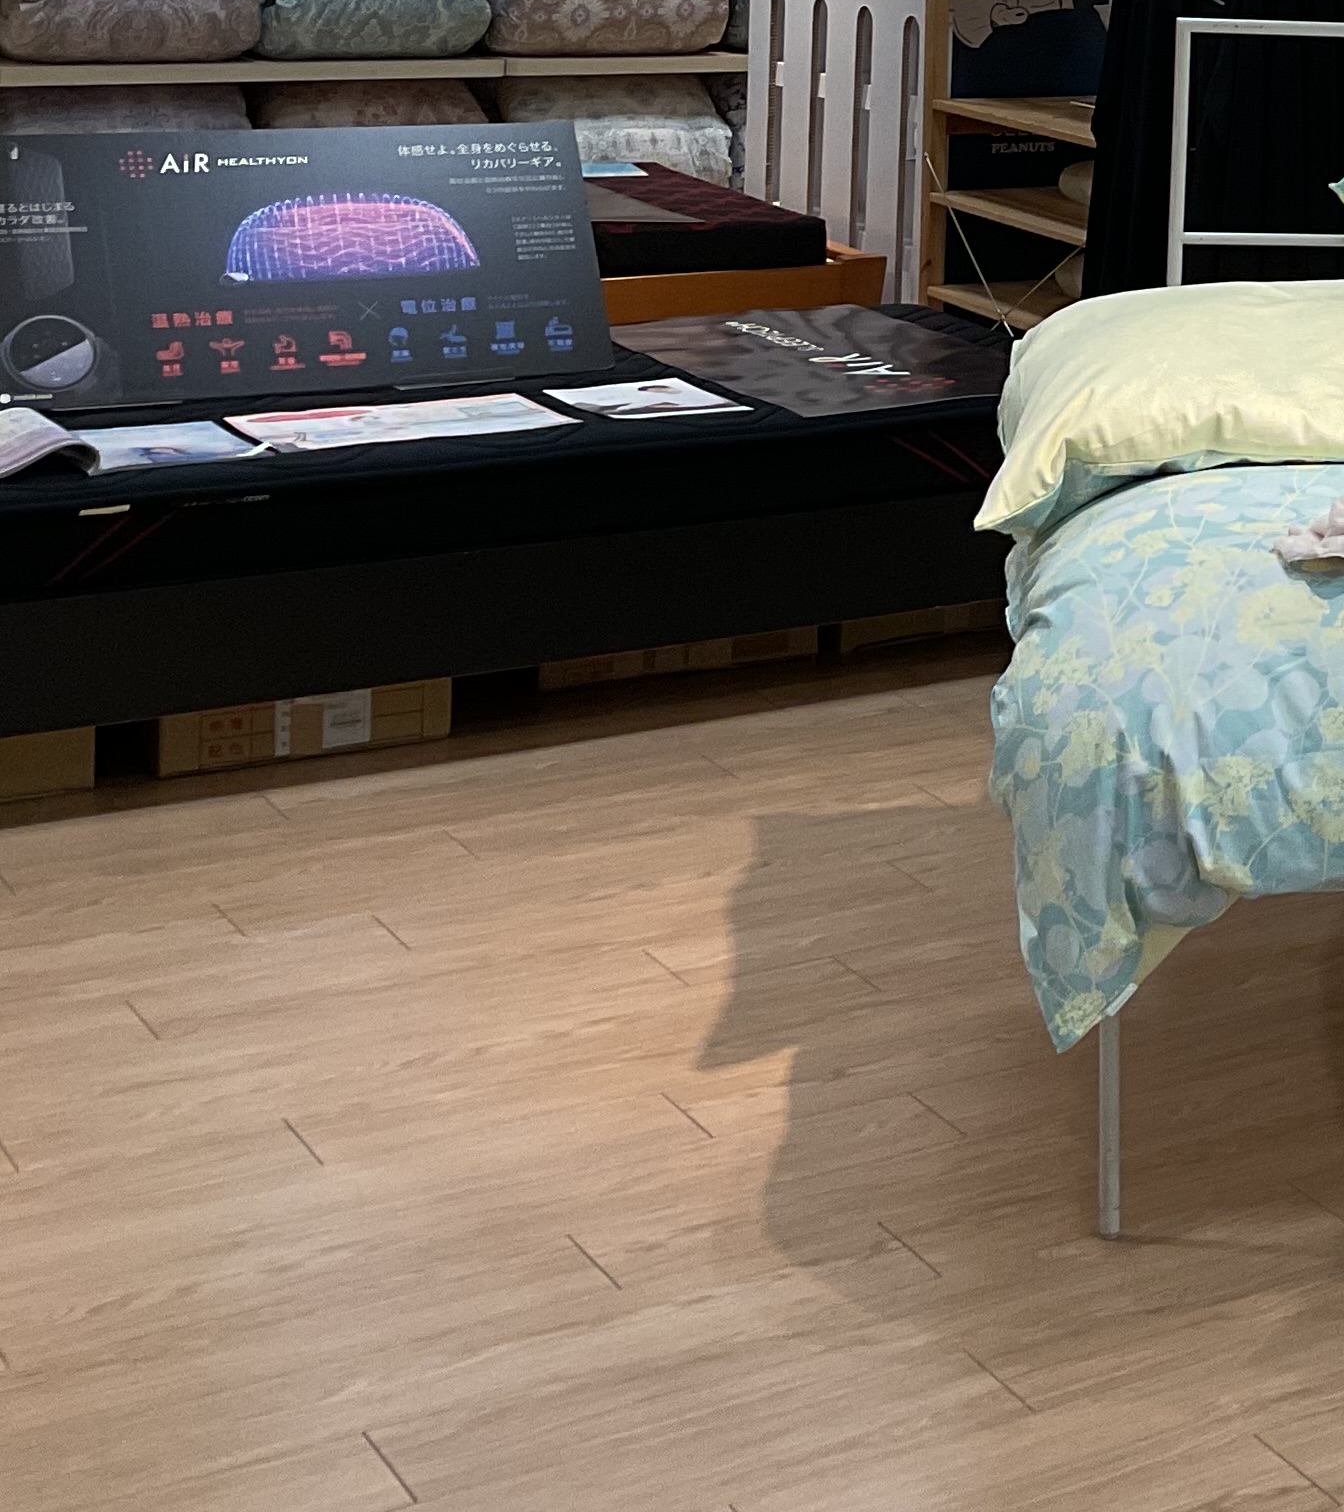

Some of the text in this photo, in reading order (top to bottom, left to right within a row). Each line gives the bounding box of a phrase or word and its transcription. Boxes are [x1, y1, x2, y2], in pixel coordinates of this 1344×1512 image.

[991, 142, 1056, 154] PEANUTS
[160, 153, 308, 174] AiR HEALTHYON
[471, 156, 562, 170] リカバリーギア。
